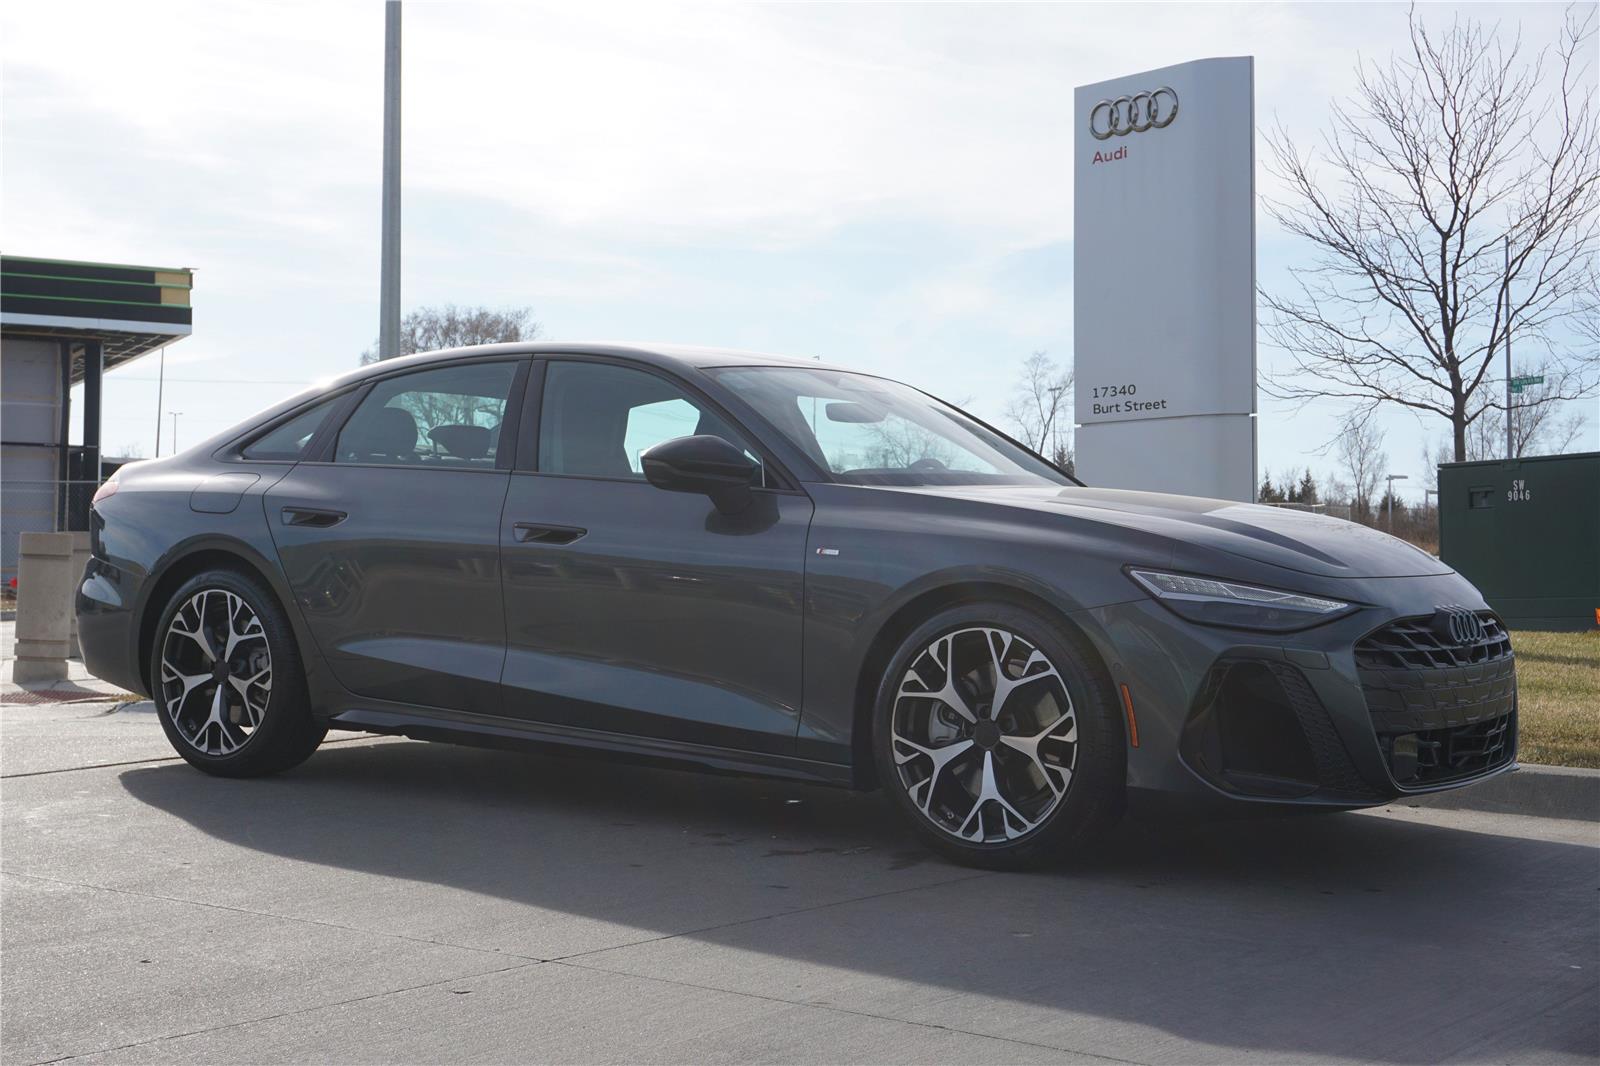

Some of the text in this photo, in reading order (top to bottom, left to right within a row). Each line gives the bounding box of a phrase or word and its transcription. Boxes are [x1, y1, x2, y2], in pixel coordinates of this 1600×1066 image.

[1092, 146, 1128, 165] Audi
[1092, 384, 1137, 399] 17340
[1093, 400, 1167, 414] Burt Street
[1513, 480, 1524, 490] SW
[1507, 490, 1530, 501] 9046
